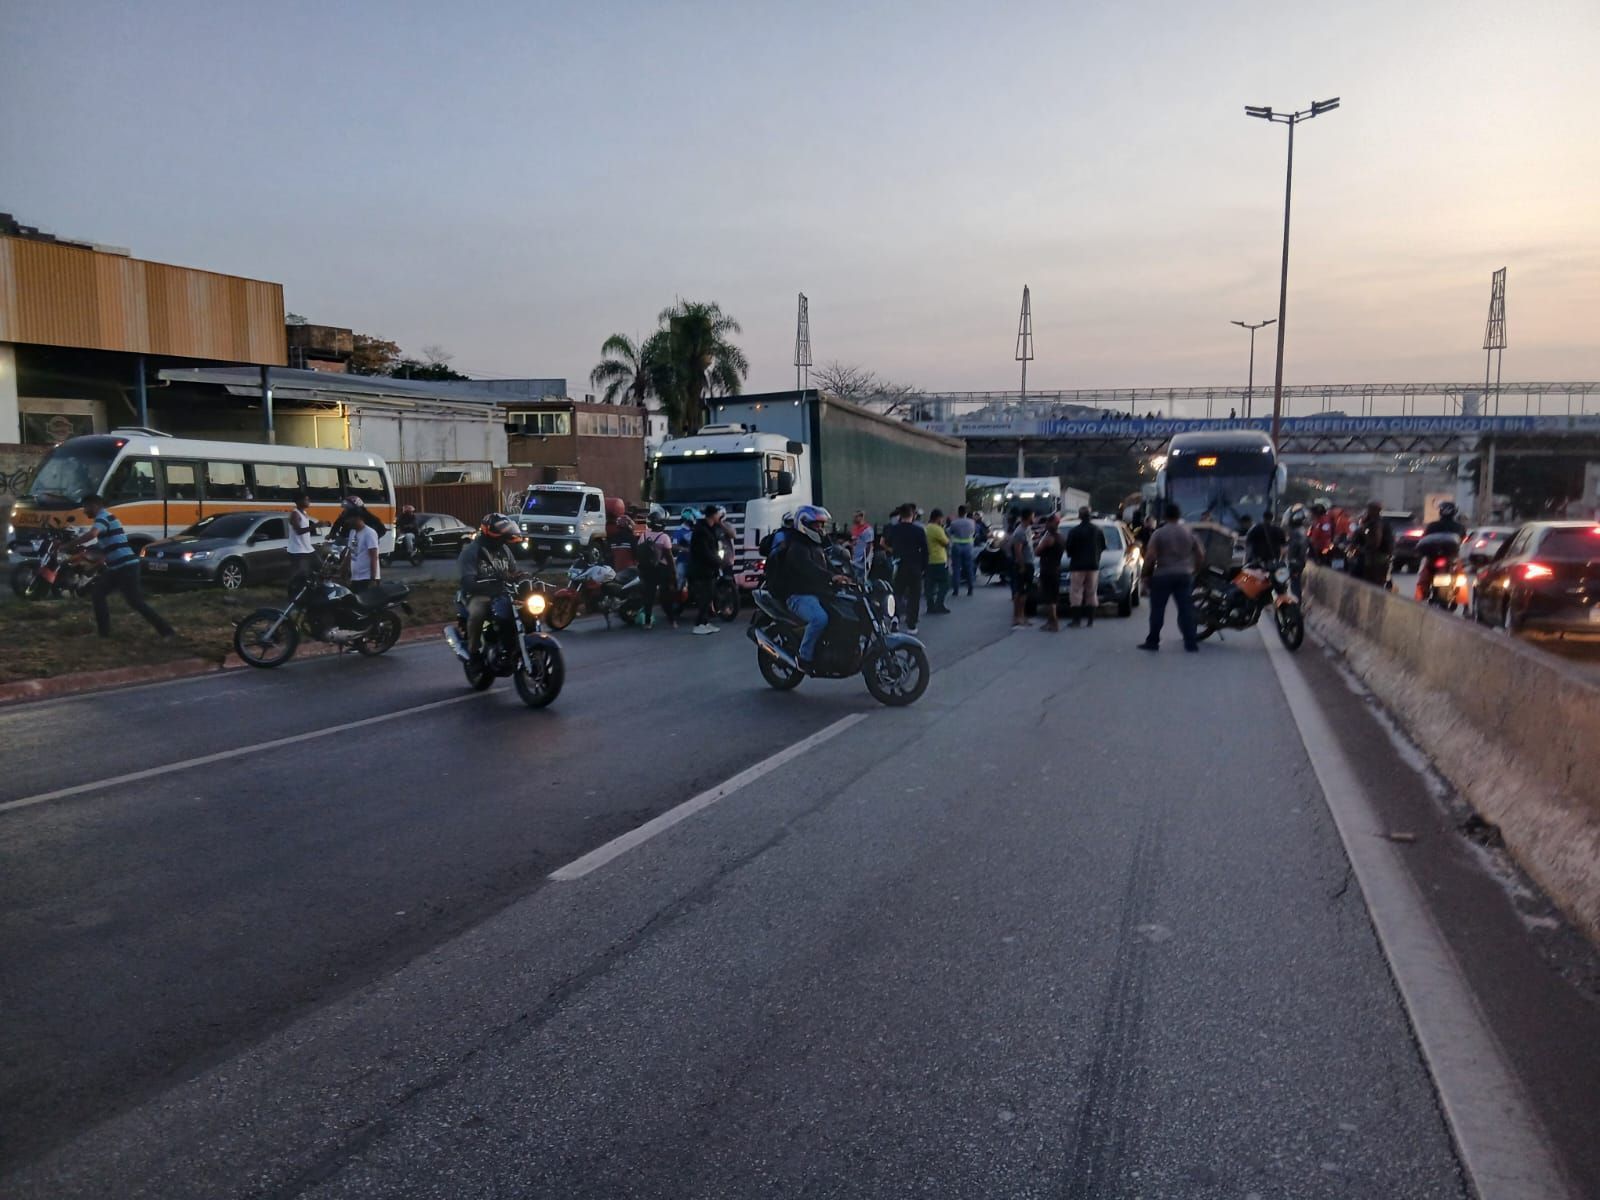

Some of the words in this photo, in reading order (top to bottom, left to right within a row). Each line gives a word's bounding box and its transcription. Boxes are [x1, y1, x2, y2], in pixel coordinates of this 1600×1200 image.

[1056, 421, 1097, 434] NOVO
[1143, 421, 1185, 433] NOVO
[1281, 420, 1292, 432] A
[1295, 419, 1387, 432] PREFEITURA
[1389, 418, 1477, 432] CUIDANDO
[1480, 418, 1500, 432] DE
